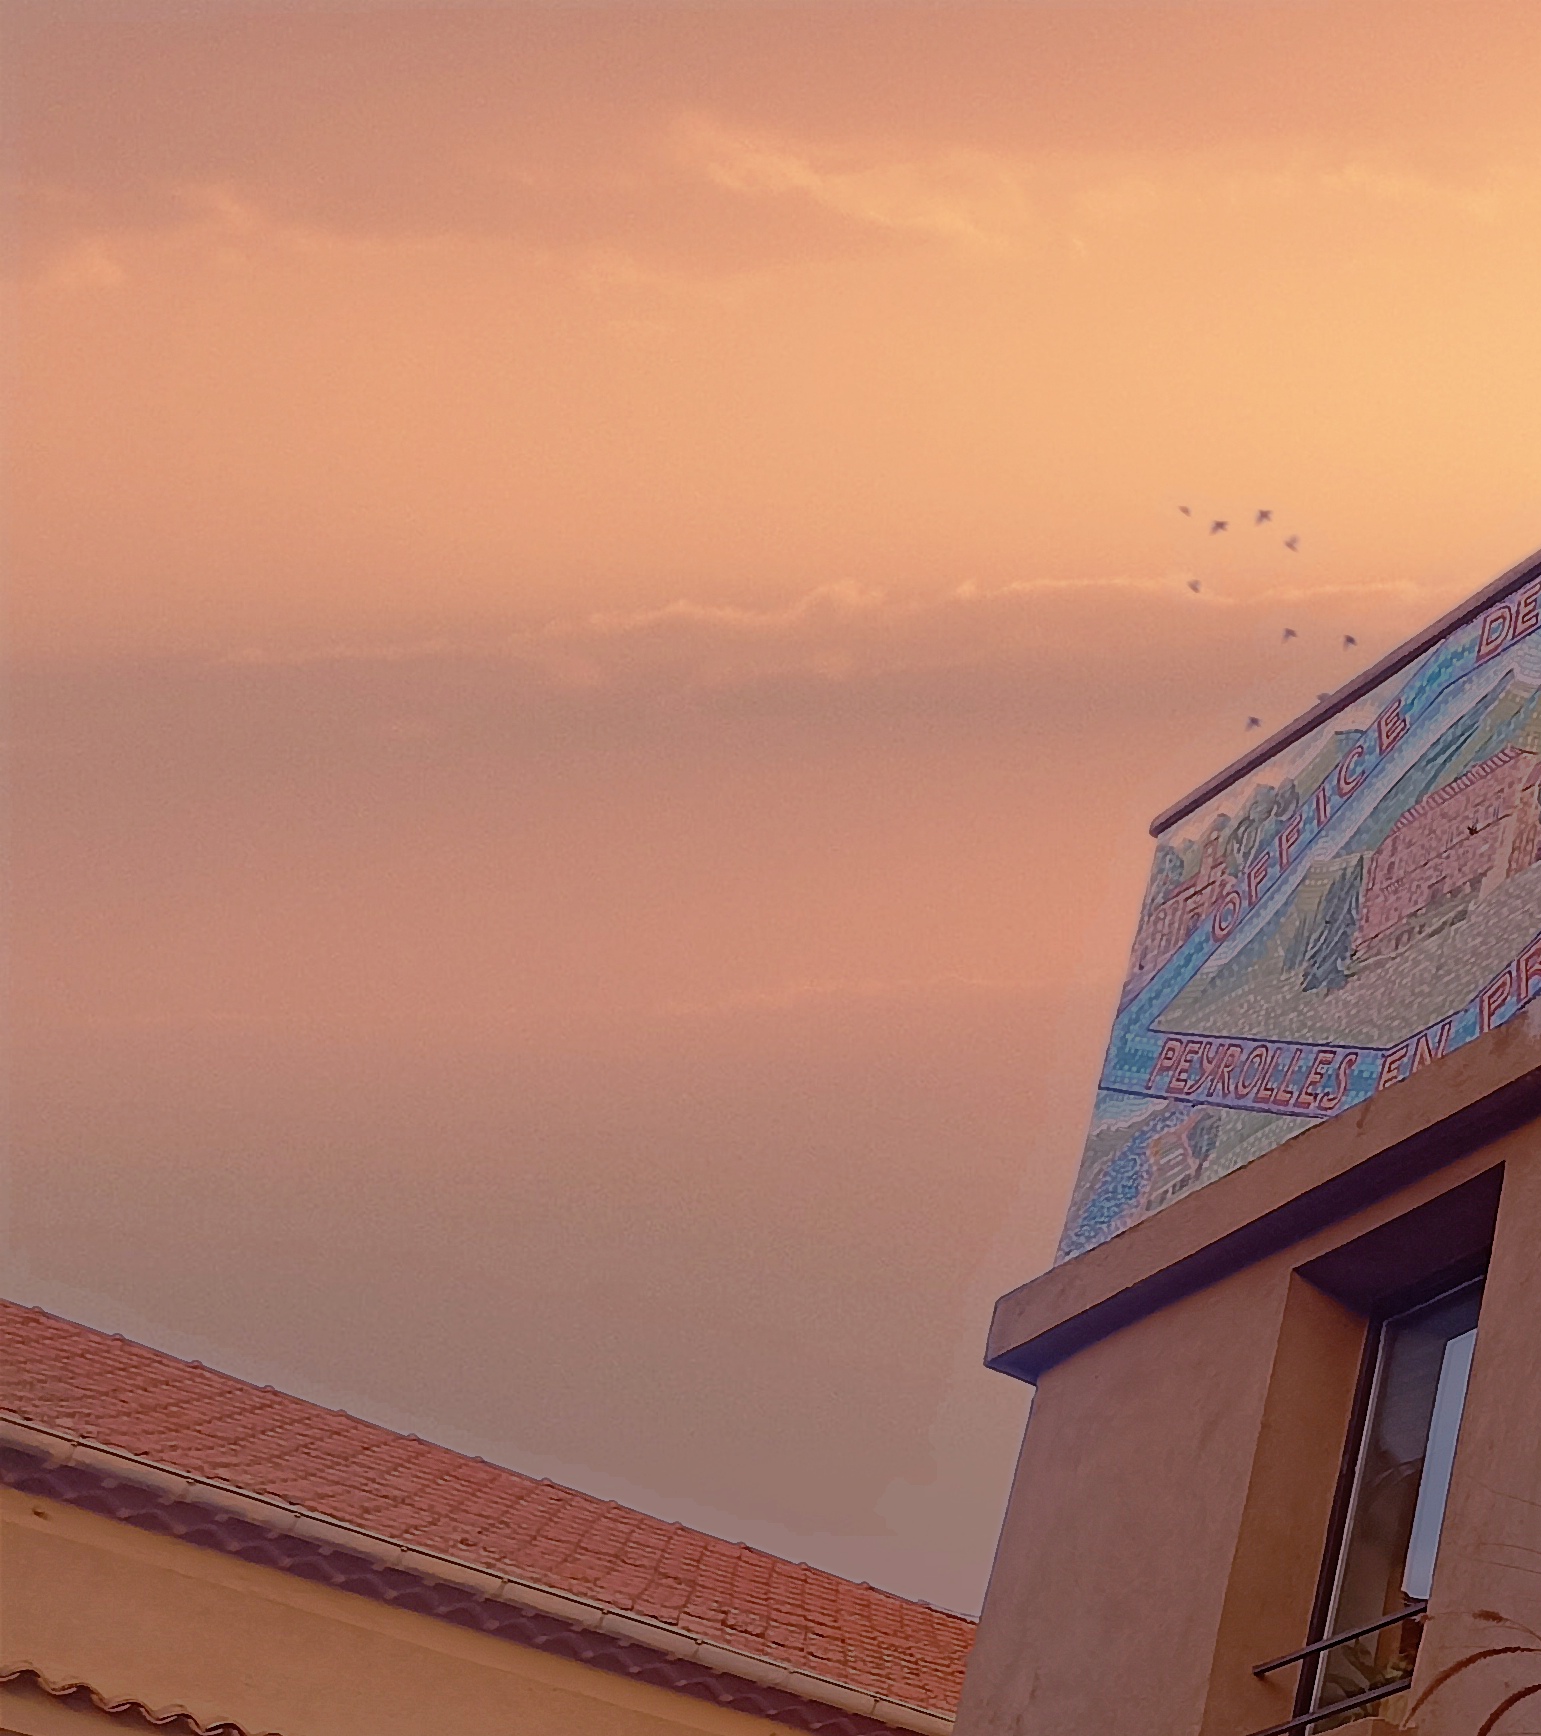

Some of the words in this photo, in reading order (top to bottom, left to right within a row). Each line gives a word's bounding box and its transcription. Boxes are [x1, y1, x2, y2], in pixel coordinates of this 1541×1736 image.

[1211, 699, 1410, 943] OFFICE
[1145, 1037, 1358, 1111] PEYROLLES
[1377, 1020, 1453, 1090] EN
